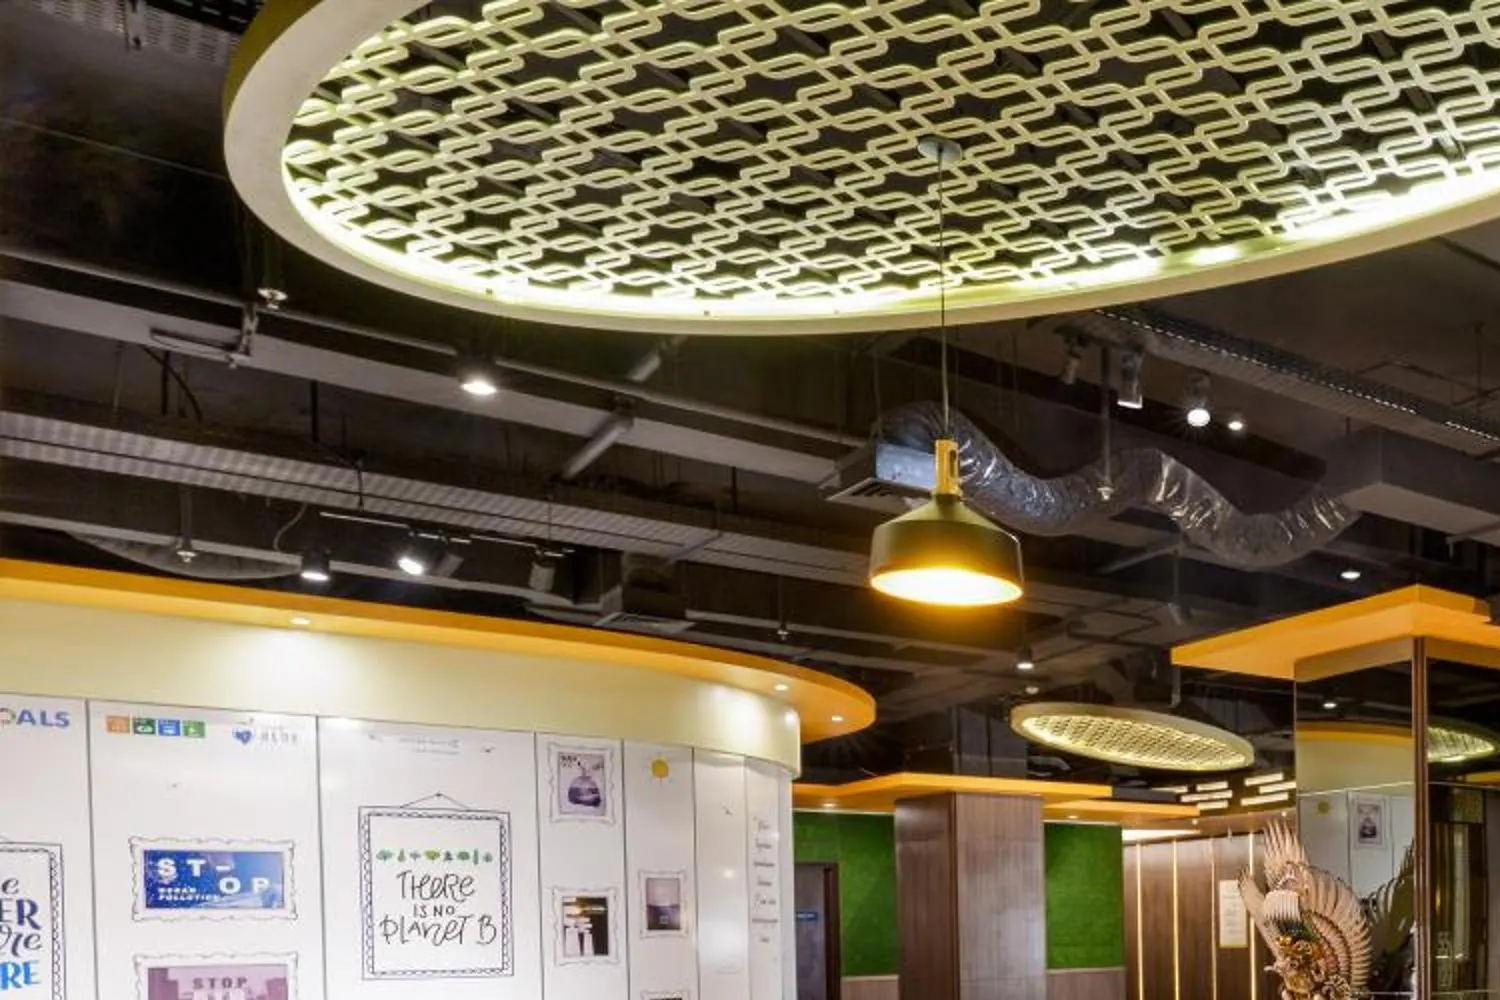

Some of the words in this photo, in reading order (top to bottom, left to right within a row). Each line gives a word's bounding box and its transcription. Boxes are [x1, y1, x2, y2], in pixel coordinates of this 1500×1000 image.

[413, 903, 428, 918] IS
[433, 903, 455, 917] NO
[476, 914, 497, 945] B
[192, 976, 248, 990] STOP
